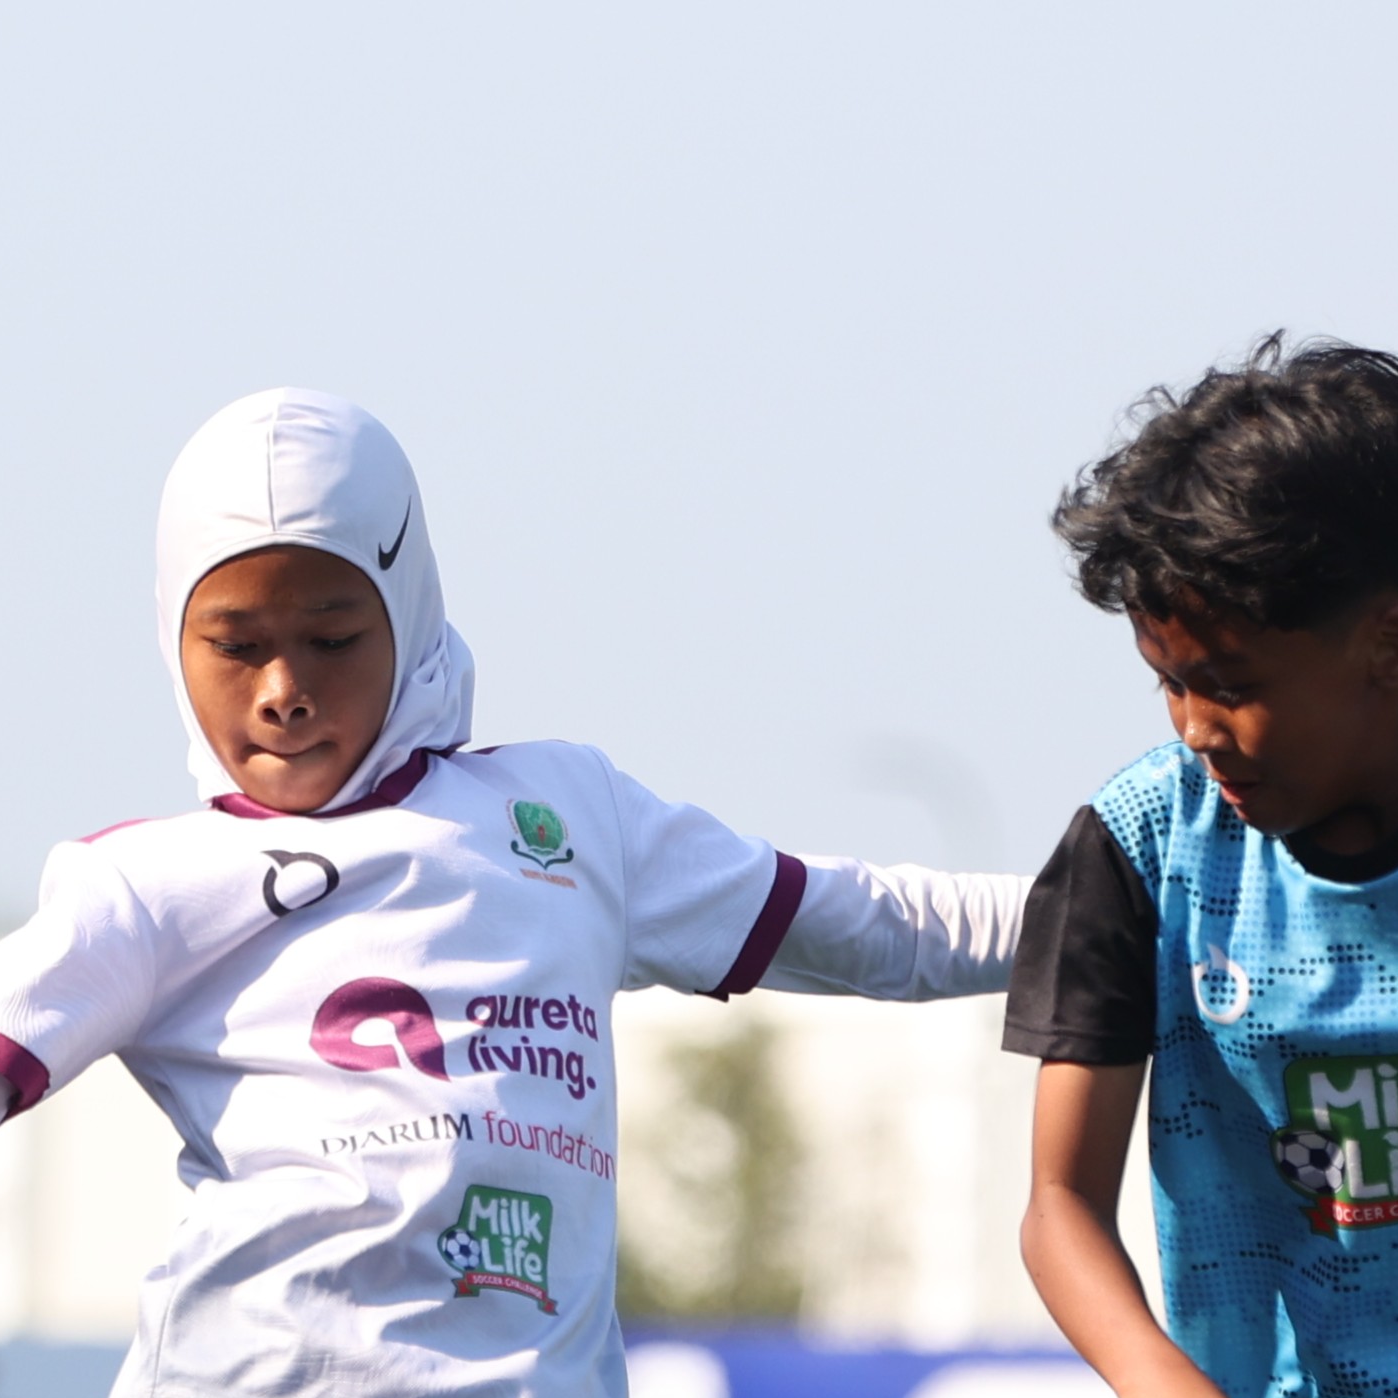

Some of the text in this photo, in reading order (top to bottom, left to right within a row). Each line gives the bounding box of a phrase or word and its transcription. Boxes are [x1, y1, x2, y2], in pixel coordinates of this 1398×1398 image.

[465, 994, 599, 1042] aureta
[468, 1034, 596, 1100] living.
[320, 1110, 617, 1182] DJARUM foundation
[468, 1195, 544, 1244] Milk
[480, 1236, 544, 1282] Life
